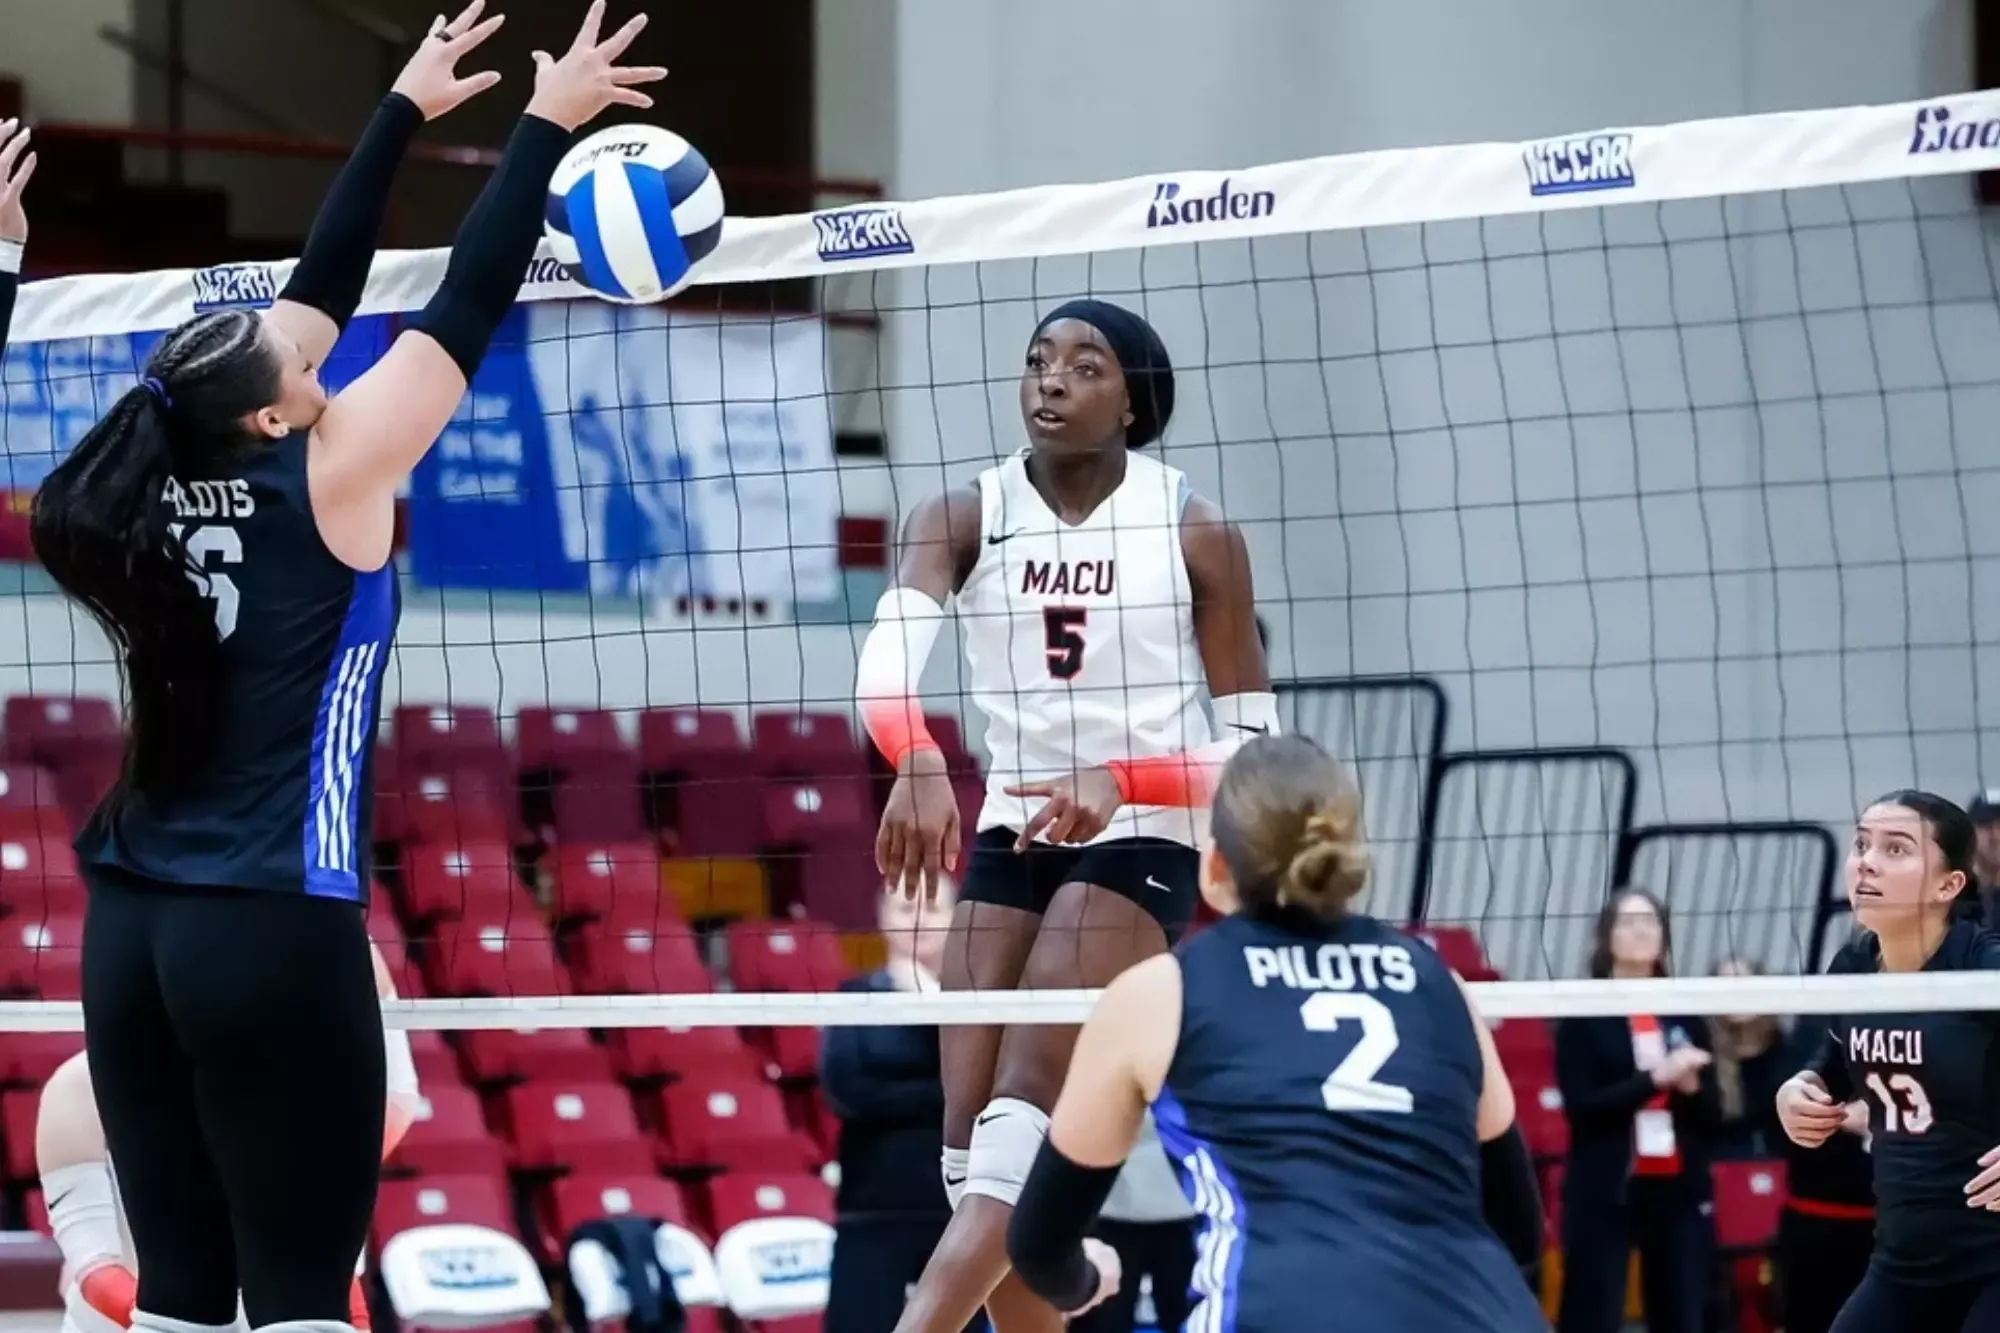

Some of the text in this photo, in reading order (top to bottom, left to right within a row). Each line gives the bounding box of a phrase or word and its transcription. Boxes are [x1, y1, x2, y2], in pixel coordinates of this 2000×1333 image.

[1522, 133, 1634, 190] NCCAA
[1147, 177, 1275, 228] Baden
[813, 208, 914, 257] NCCAA
[1021, 559, 1114, 596] MACU
[1042, 605, 1087, 680] 5
[1243, 943, 1417, 993] PILOTS
[1300, 992, 1415, 1113] 2
[1850, 1026, 1922, 1065] MACU
[1865, 1072, 1933, 1134] 13
